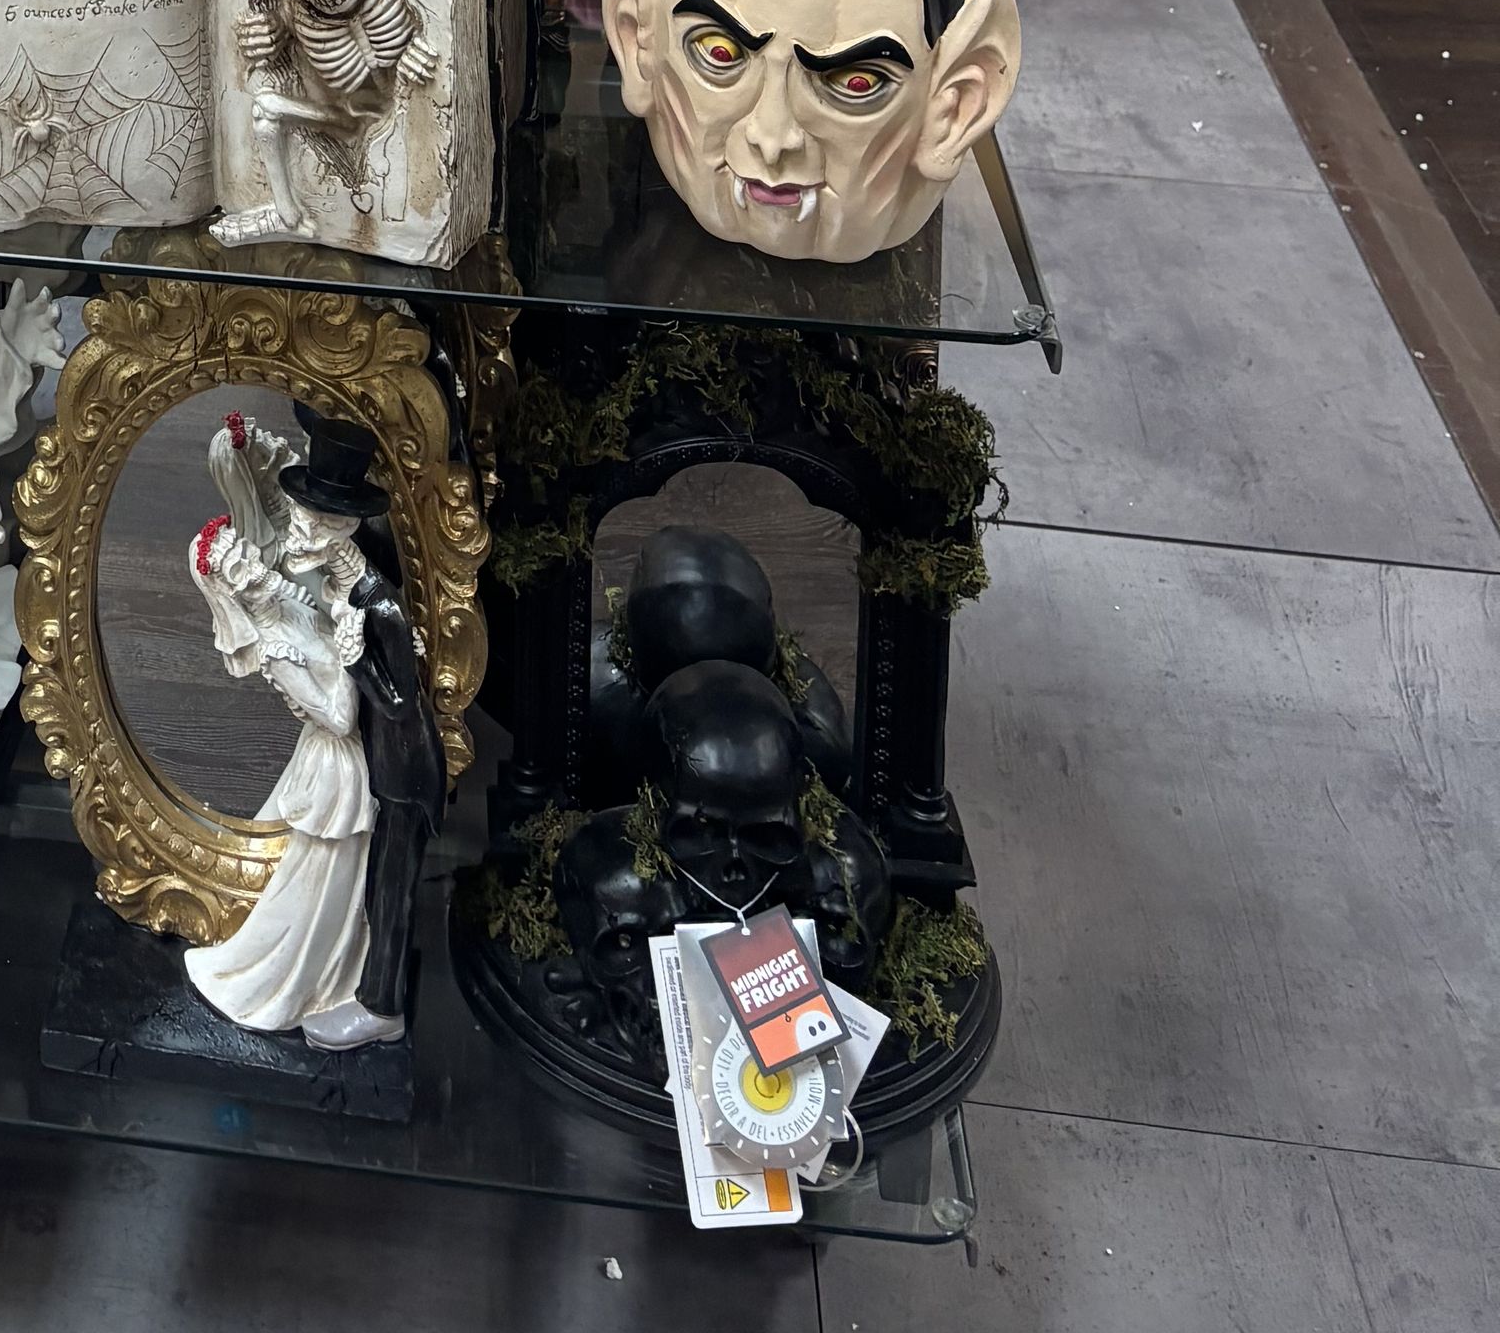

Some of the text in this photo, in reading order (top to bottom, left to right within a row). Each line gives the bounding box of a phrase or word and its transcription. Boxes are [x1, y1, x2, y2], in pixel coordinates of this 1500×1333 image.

[23, 7, 73, 19] ounces
[74, 0, 90, 21] of
[730, 949, 800, 996] MIDNIGHT
[738, 965, 810, 1013] FRIGHT
[716, 1046, 736, 1071] LED
[715, 1081, 768, 1142] DECOR A DEL
